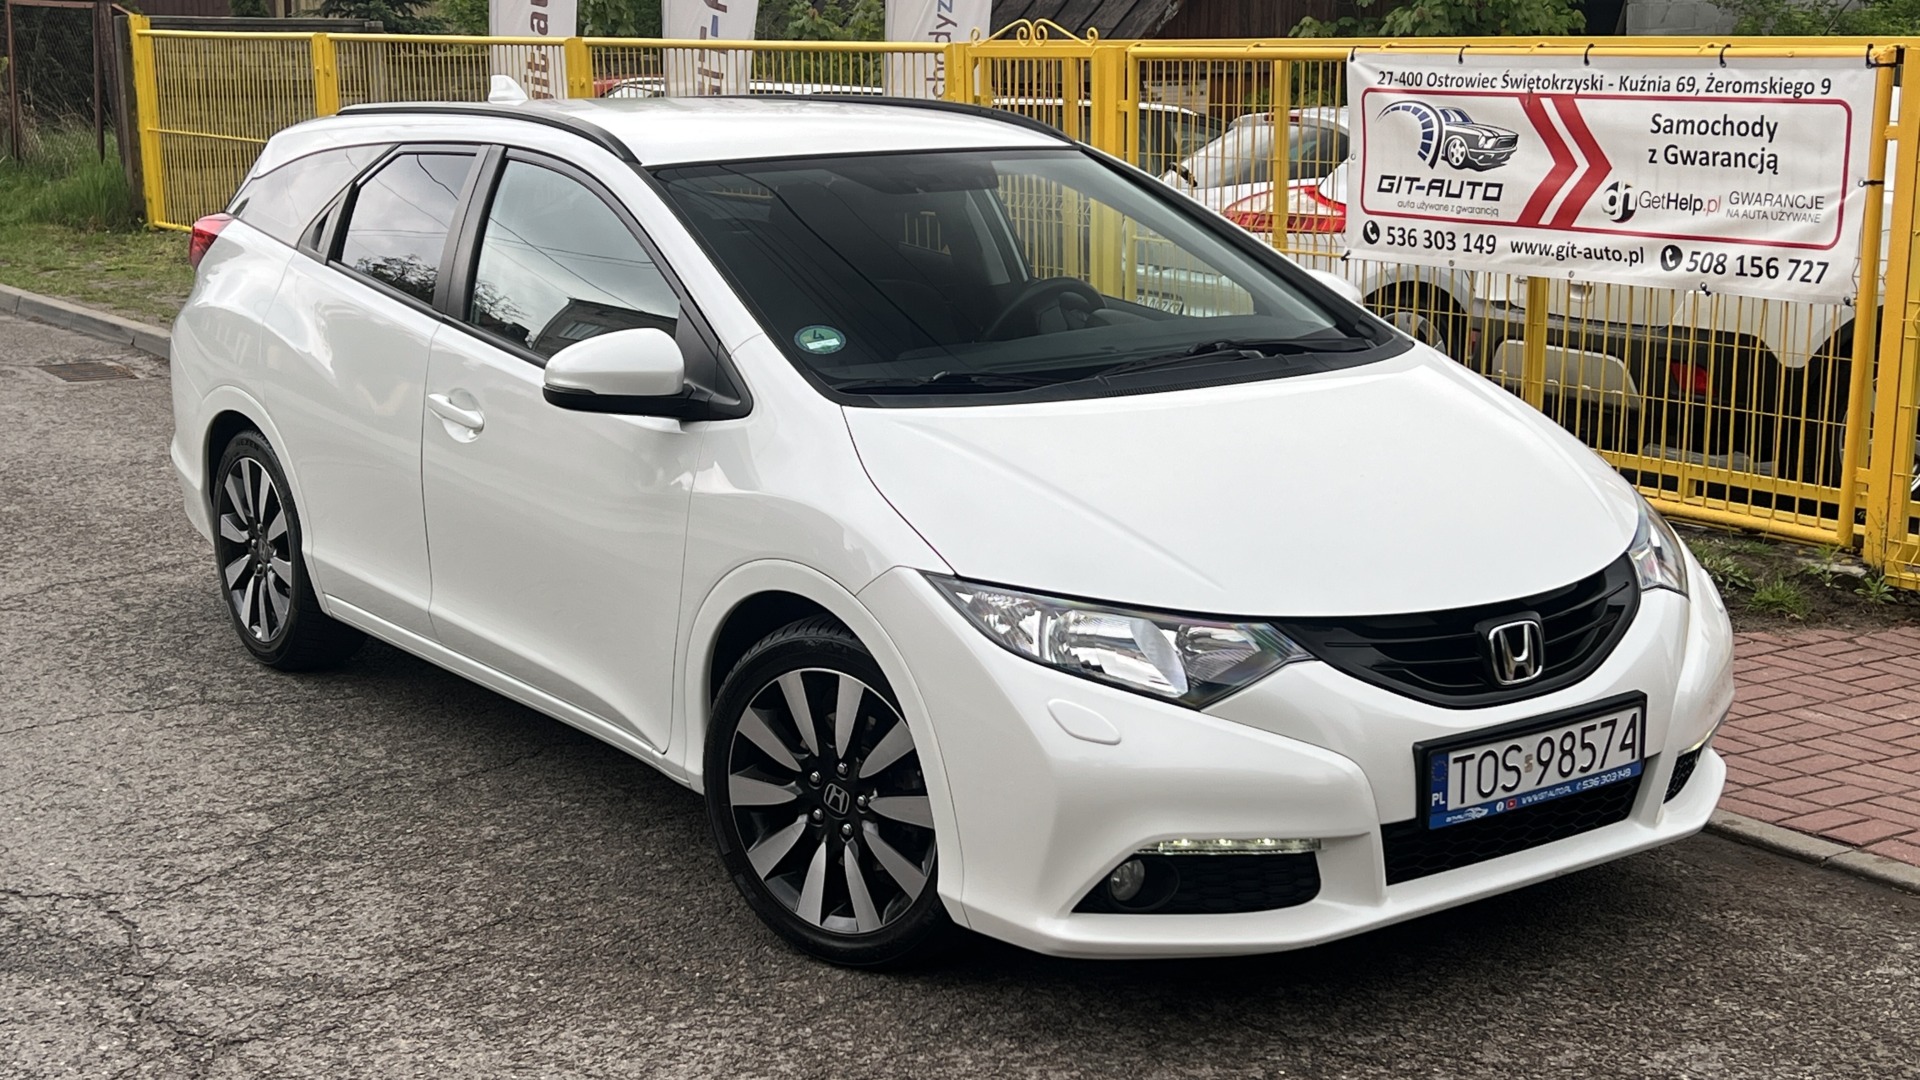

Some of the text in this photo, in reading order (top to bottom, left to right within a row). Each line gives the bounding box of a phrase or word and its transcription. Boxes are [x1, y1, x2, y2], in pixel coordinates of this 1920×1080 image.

[1377, 71, 1422, 87] 27-400
[1426, 72, 1497, 89] Ostrowiec
[1500, 70, 1604, 94] Świętokrzyski
[1619, 75, 1671, 93] Kuźnia
[1676, 76, 1700, 96] 69,
[1705, 72, 1815, 98] Żeromskiego
[1820, 78, 1832, 95] 9
[1650, 112, 1778, 143] Samochody
[1648, 144, 1779, 175] z Gwarancją
[1377, 175, 1503, 201] GIT-AUTO
[1729, 191, 1825, 210] GWARANCJE
[1397, 200, 1415, 209] auta
[1417, 201, 1449, 213] używane
[1456, 205, 1499, 217] gwarancją
[1638, 190, 1721, 219] GetHelp.pl
[1726, 209, 1821, 223] NA AUTA UŻYWANE
[1386, 226, 1497, 255] 536 303 149
[1510, 239, 1644, 267] www.git-auto.pl
[1686, 251, 1830, 285] 508 156 727
[1452, 713, 1638, 805] TOS 98574
[1582, 777, 1600, 789] 536
[1601, 772, 1617, 784] 303
[1431, 792, 1446, 807] PL
